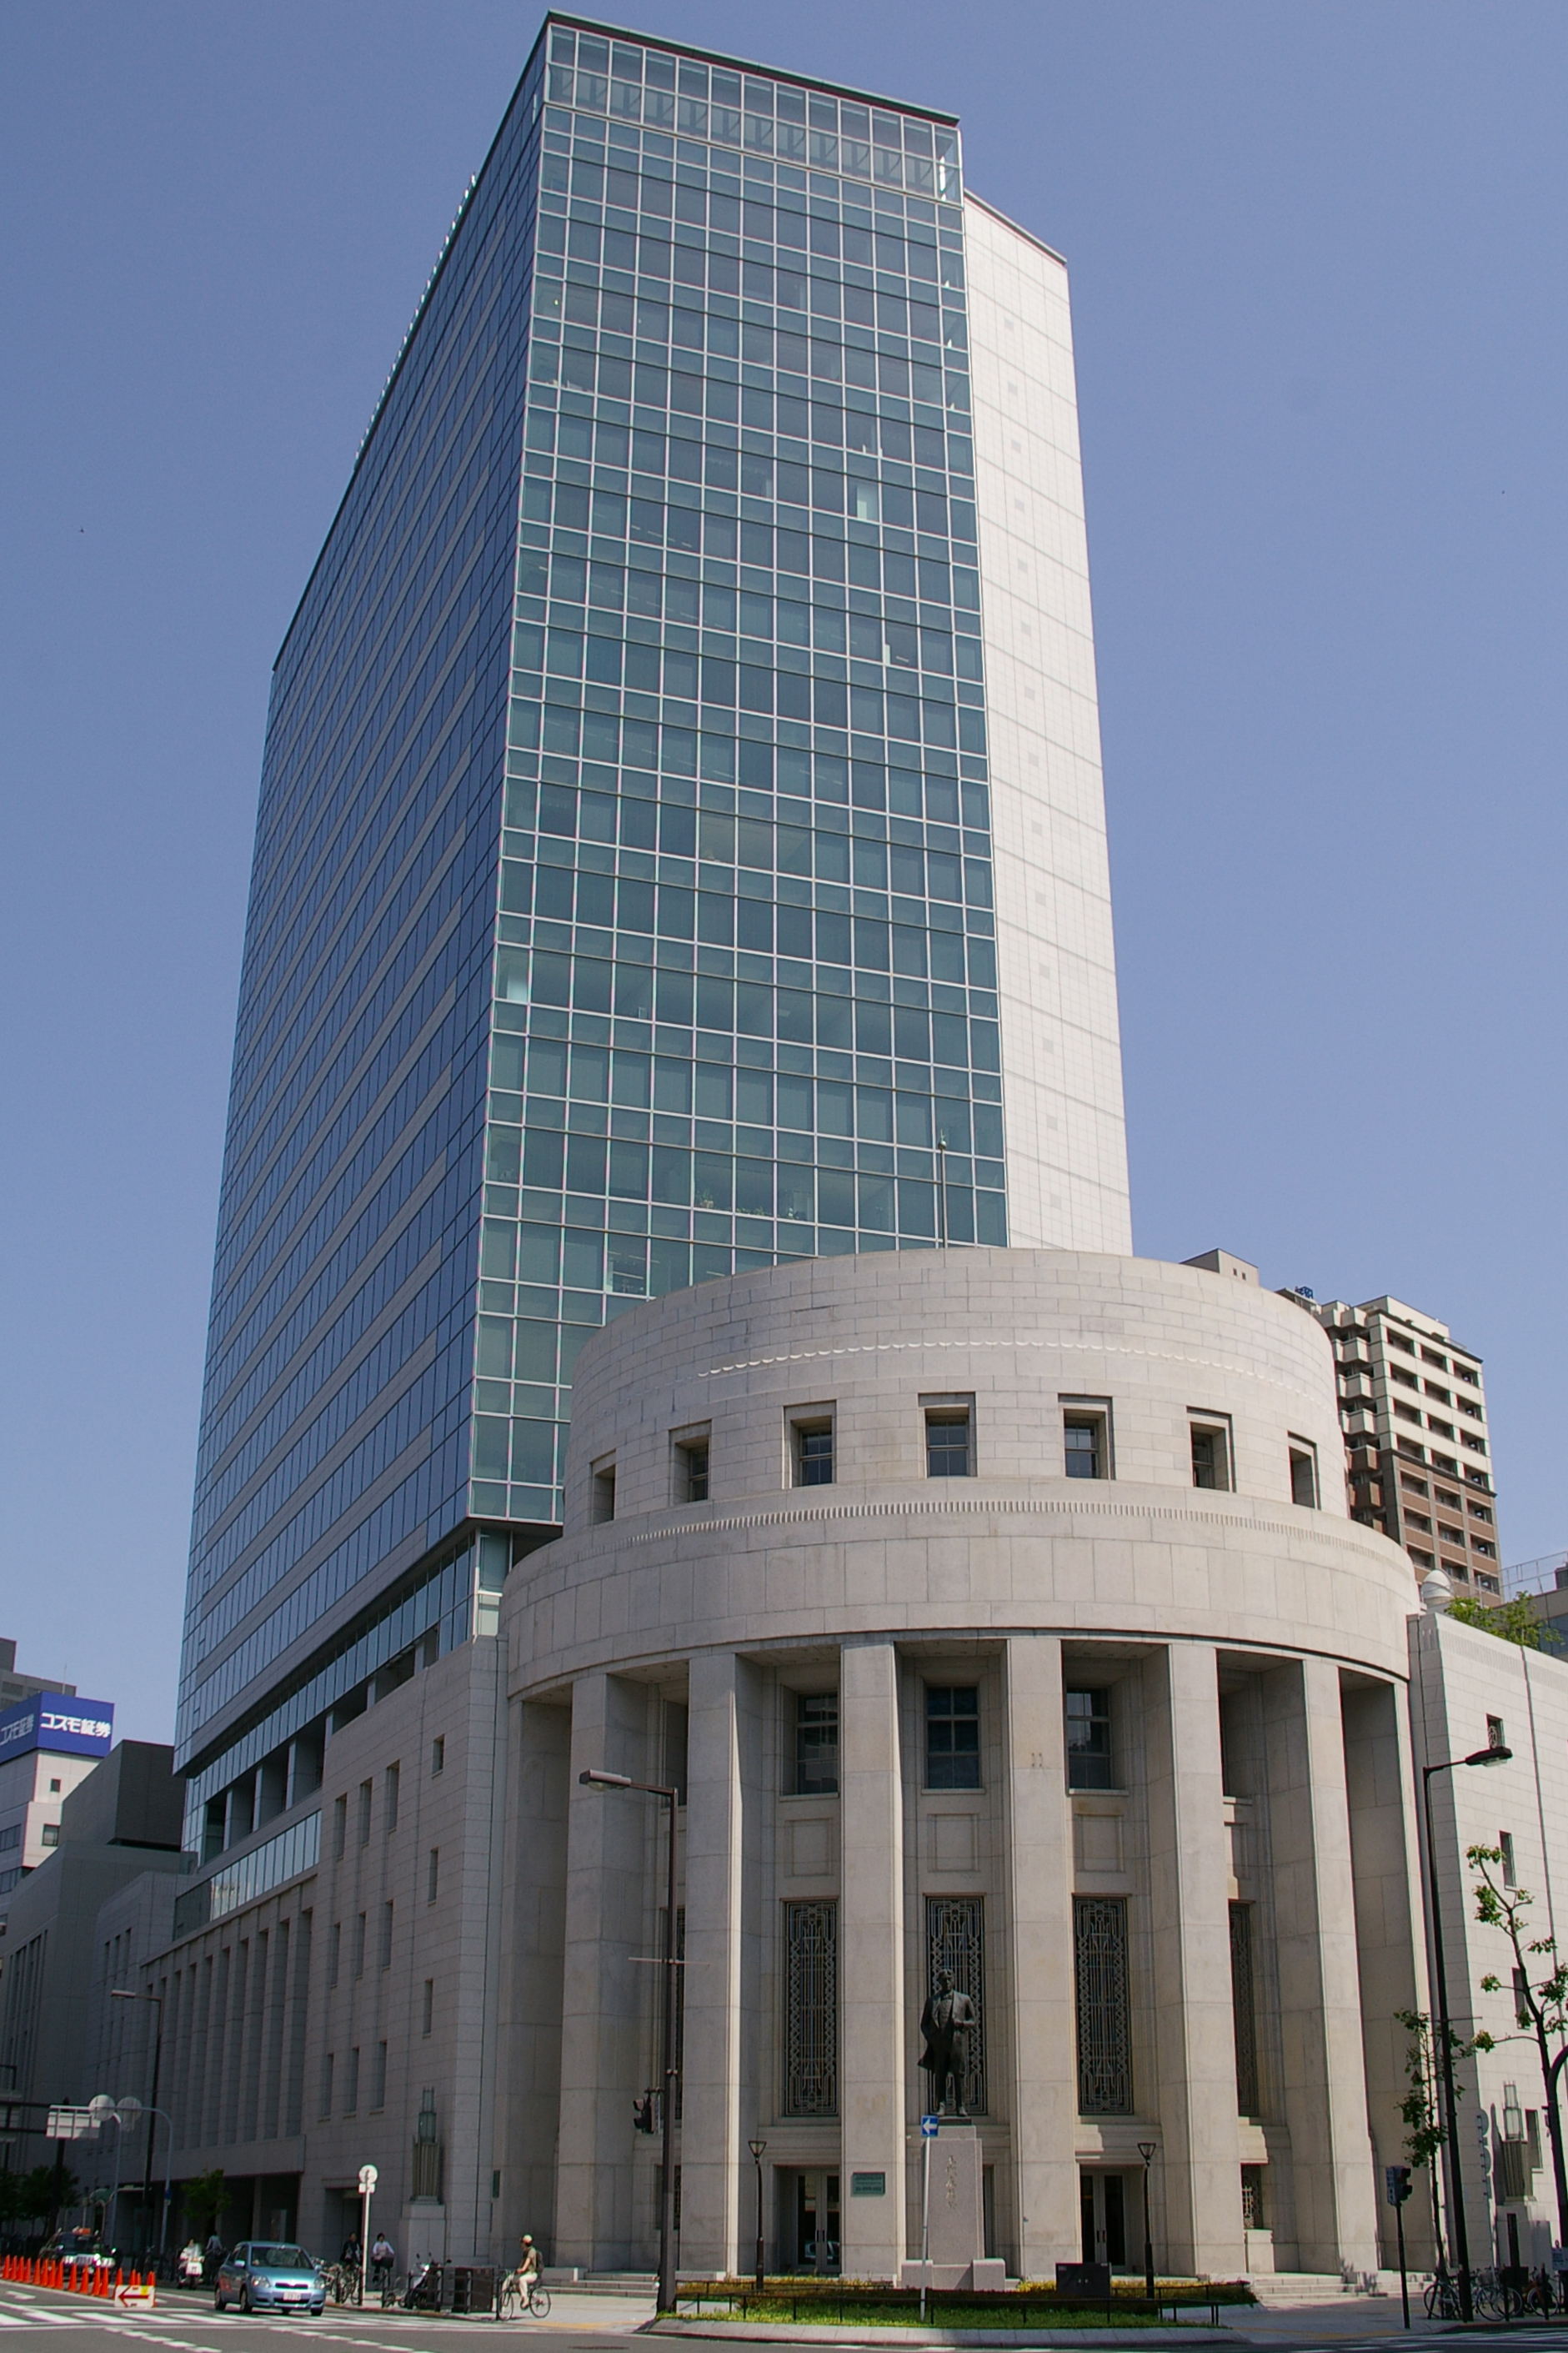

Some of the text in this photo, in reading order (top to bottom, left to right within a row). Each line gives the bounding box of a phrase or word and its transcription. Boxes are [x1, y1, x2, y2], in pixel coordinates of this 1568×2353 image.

[40, 1712, 111, 1738] コスモ証券
